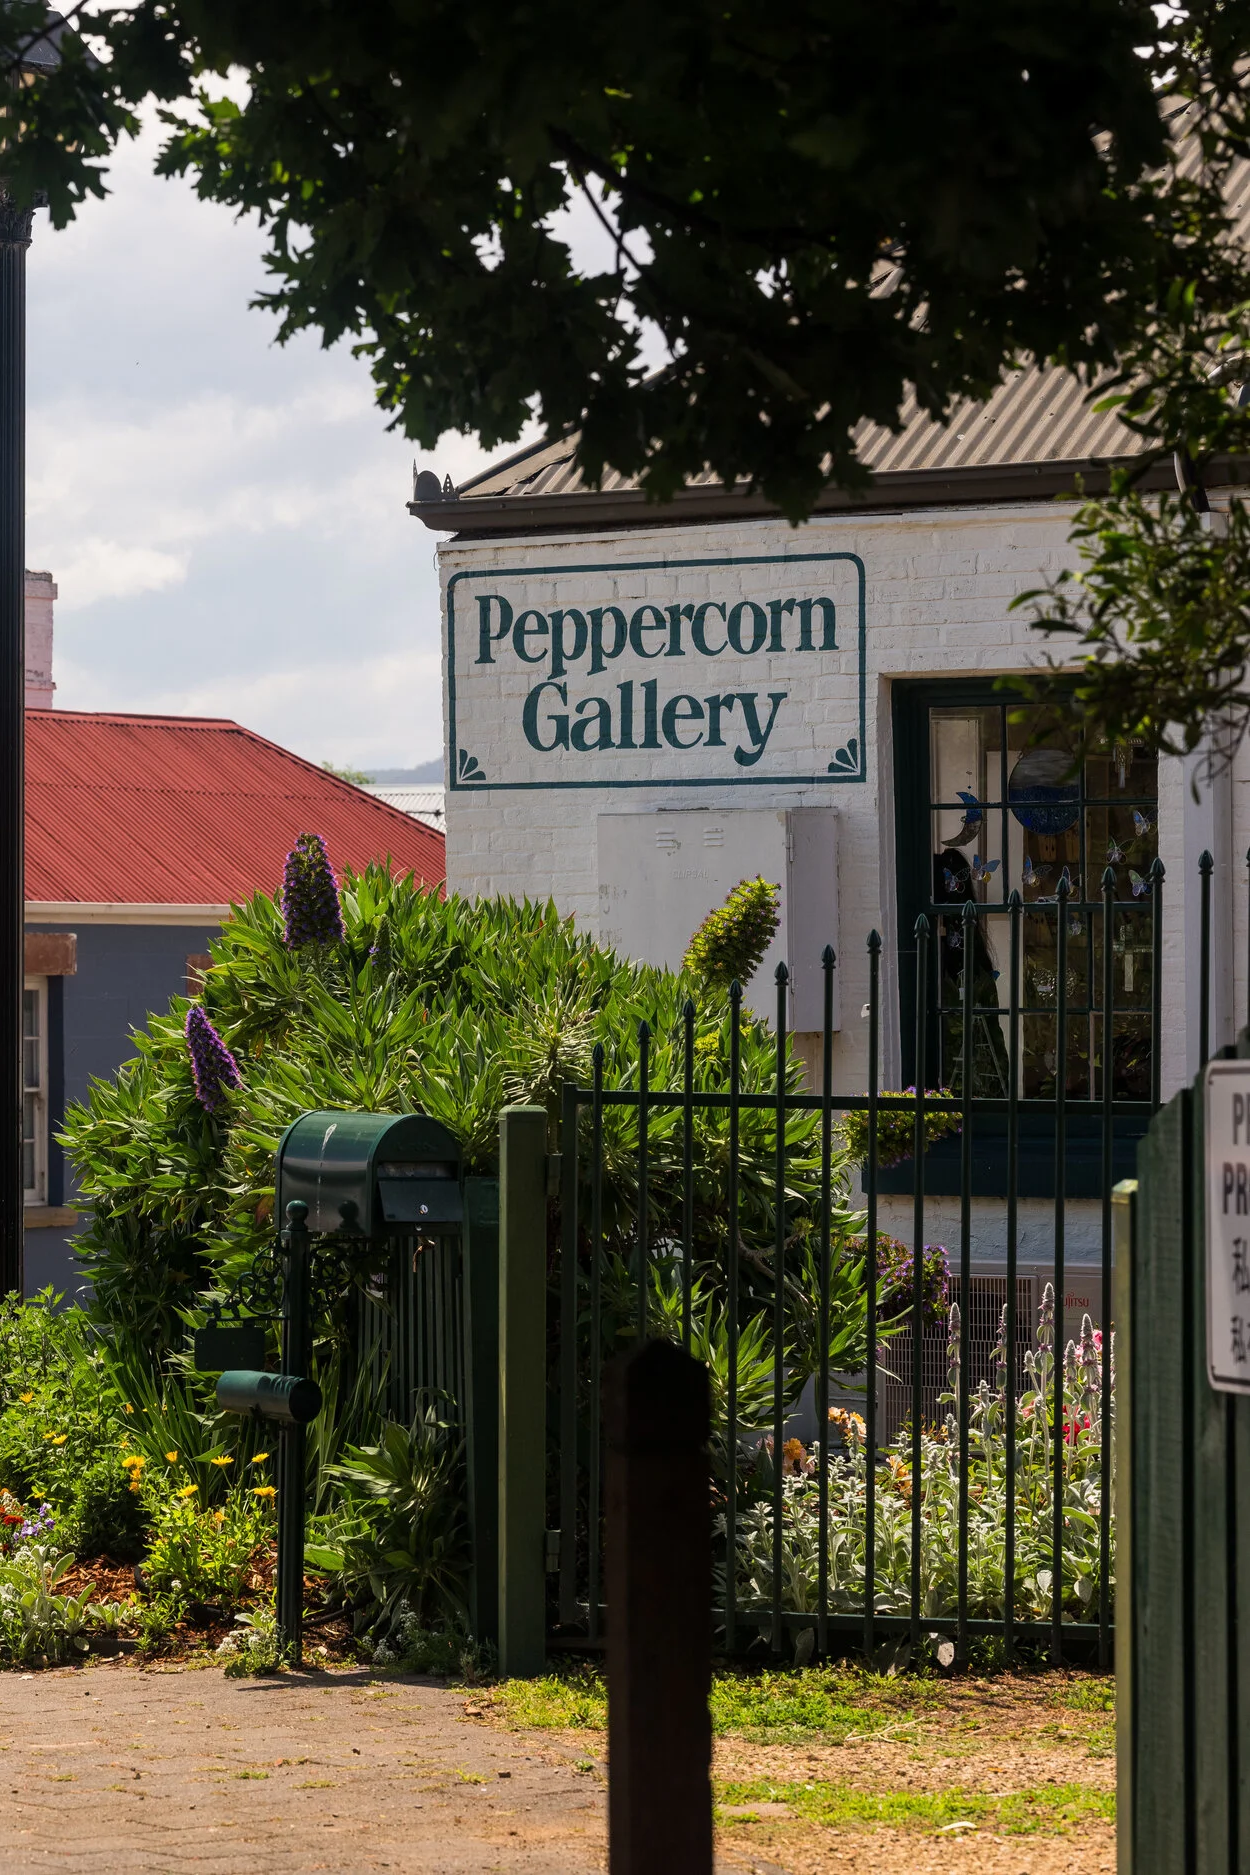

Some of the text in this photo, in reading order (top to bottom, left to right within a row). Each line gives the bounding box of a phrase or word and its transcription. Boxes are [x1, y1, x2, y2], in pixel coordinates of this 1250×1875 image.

[474, 594, 840, 680] Peppercorn
[522, 678, 788, 766] Gallery
[672, 867, 710, 880] CLIPSAL
[1222, 1161, 1250, 1216] PR
